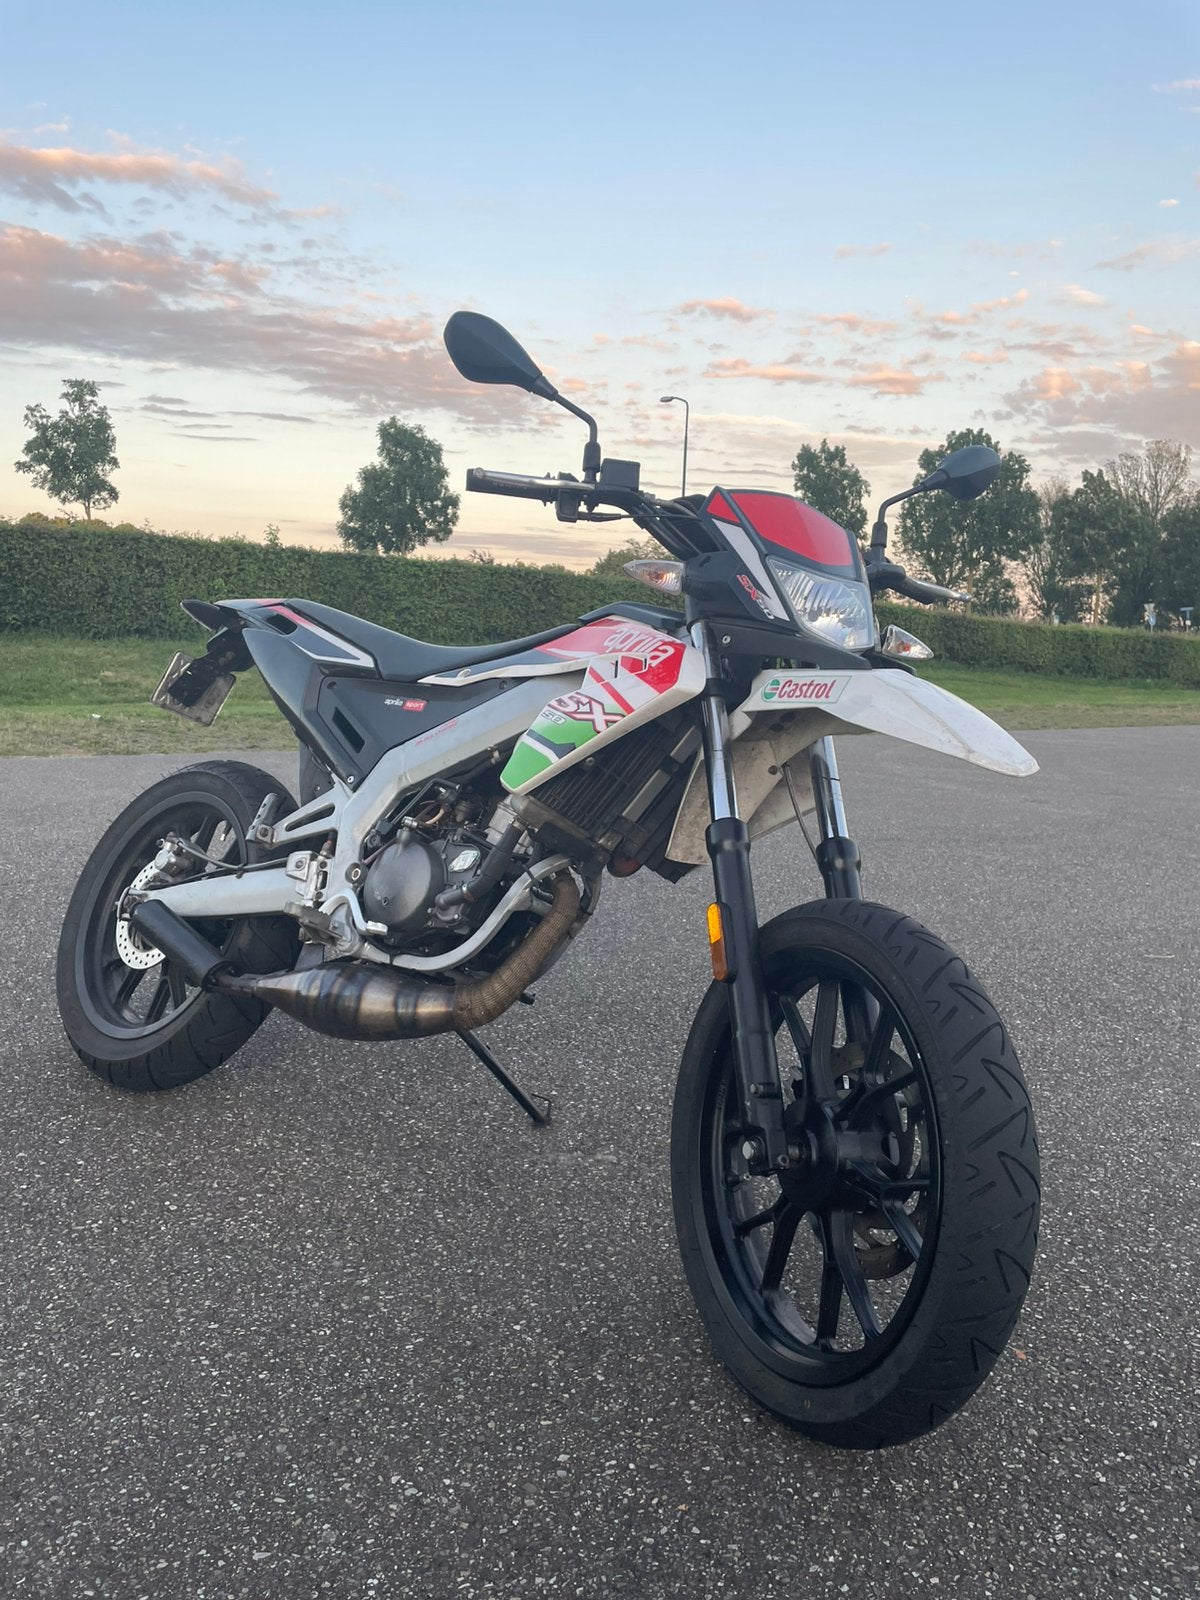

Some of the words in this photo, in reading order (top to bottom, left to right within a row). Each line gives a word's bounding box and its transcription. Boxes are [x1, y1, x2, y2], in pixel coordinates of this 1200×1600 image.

[603, 626, 675, 668] aprilia
[777, 679, 837, 699] Castrol
[405, 701, 425, 709] sport
